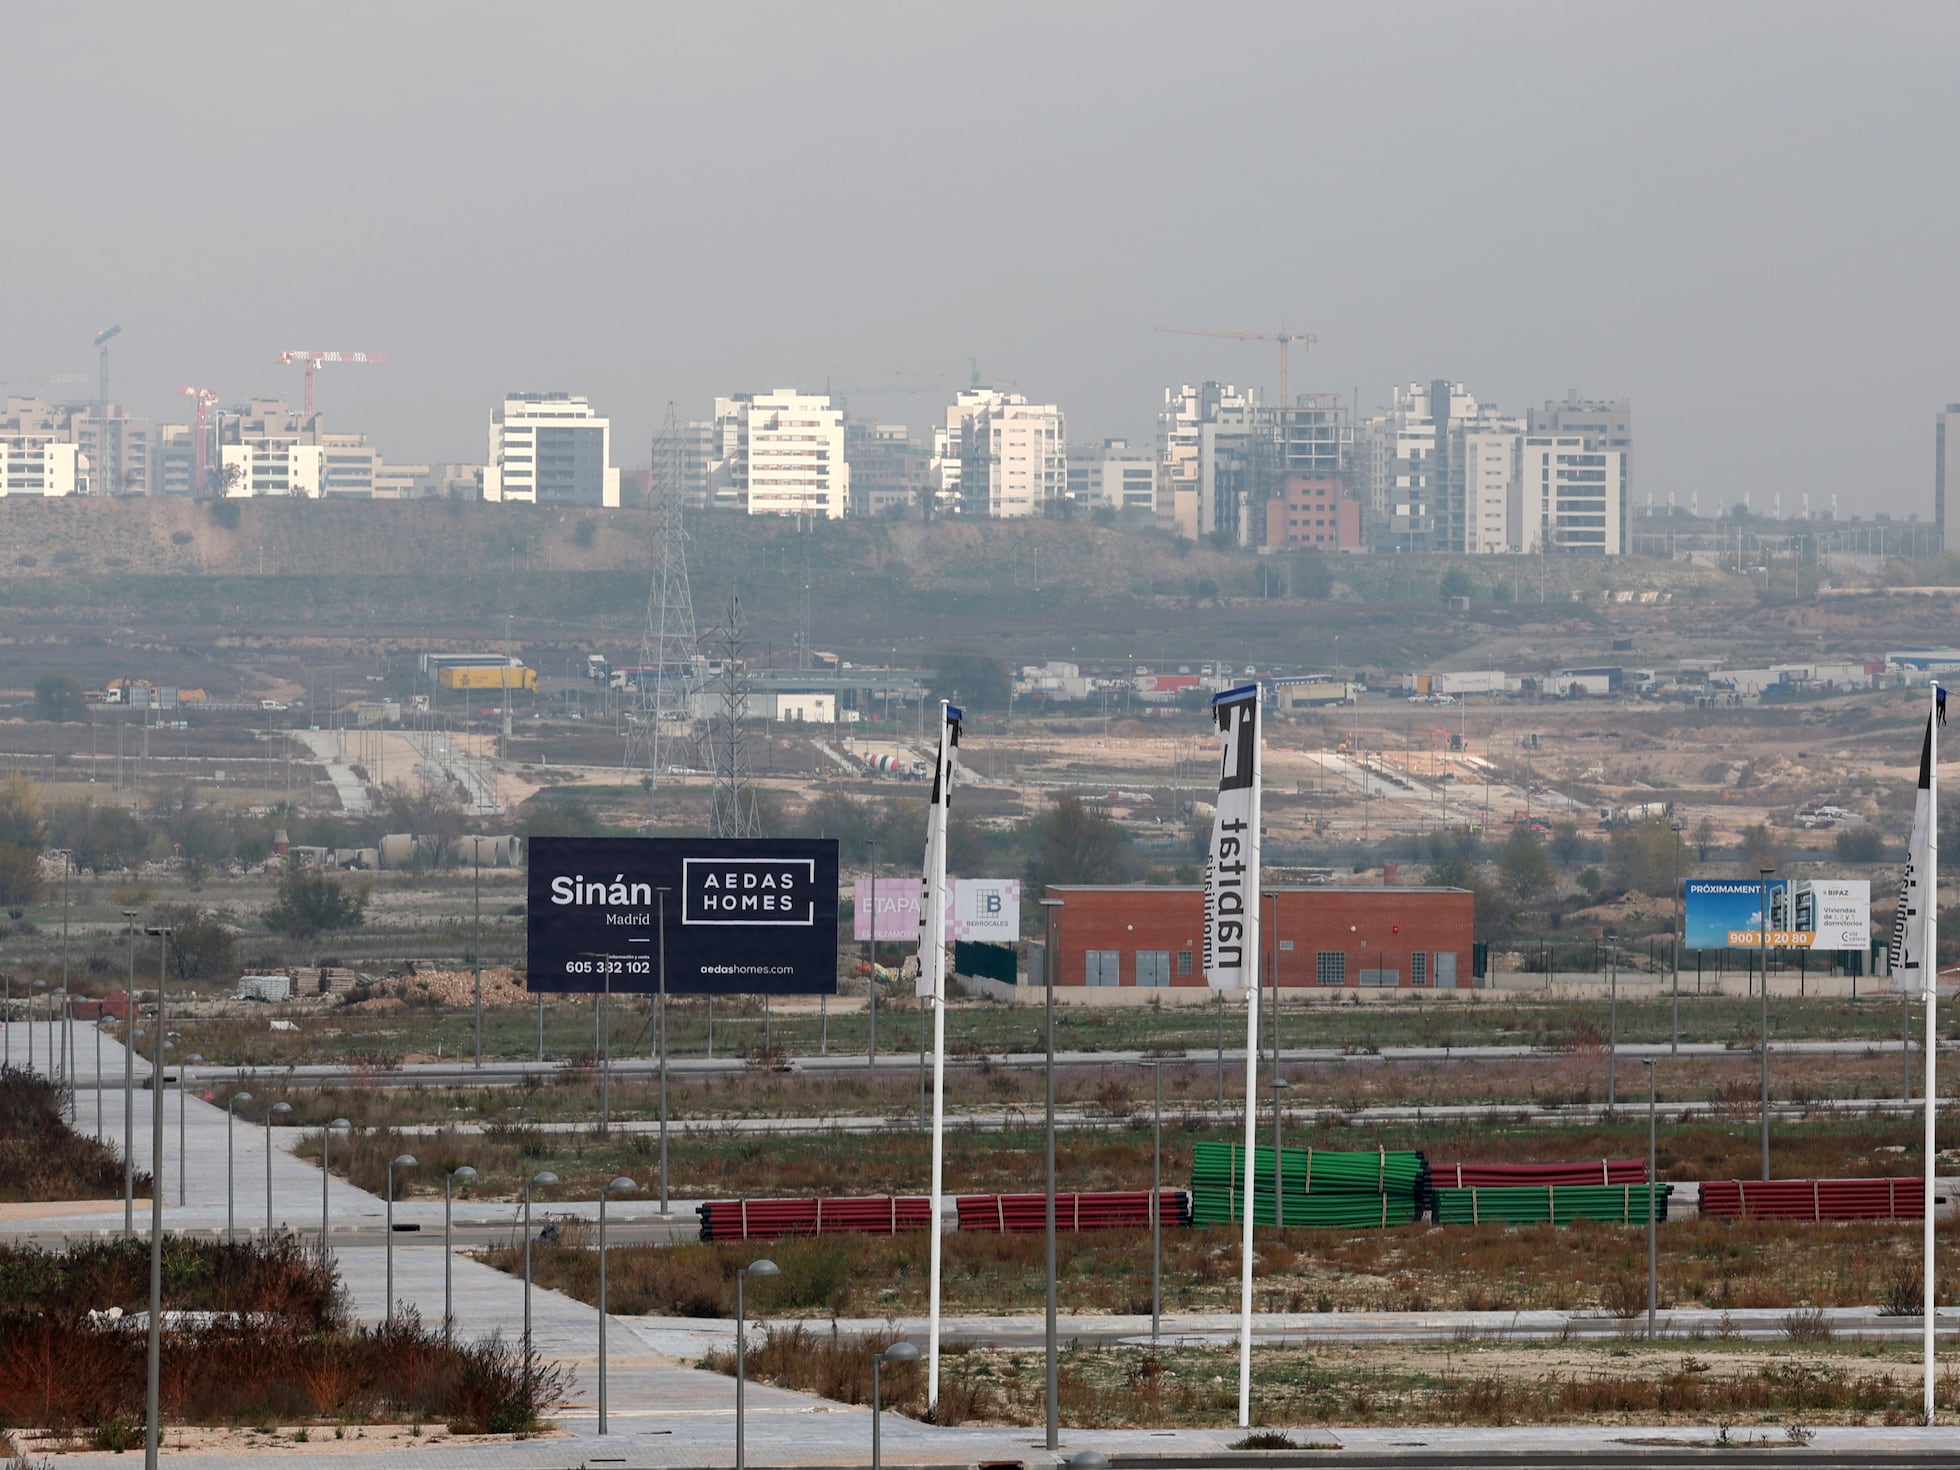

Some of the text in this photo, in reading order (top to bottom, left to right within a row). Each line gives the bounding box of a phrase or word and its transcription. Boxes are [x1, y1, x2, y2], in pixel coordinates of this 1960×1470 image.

[704, 873, 793, 889] AEDAS
[551, 873, 651, 905] Sinán
[704, 895, 793, 911] HOMES
[862, 898, 921, 913] ETAPA
[606, 913, 650, 925] Madrid
[1730, 933, 1753, 944] 900
[1774, 933, 1789, 944] 20
[1791, 933, 1807, 944] 80
[565, 961, 592, 973] 605
[626, 961, 650, 973] 102
[700, 964, 794, 975] aedashomes.com
